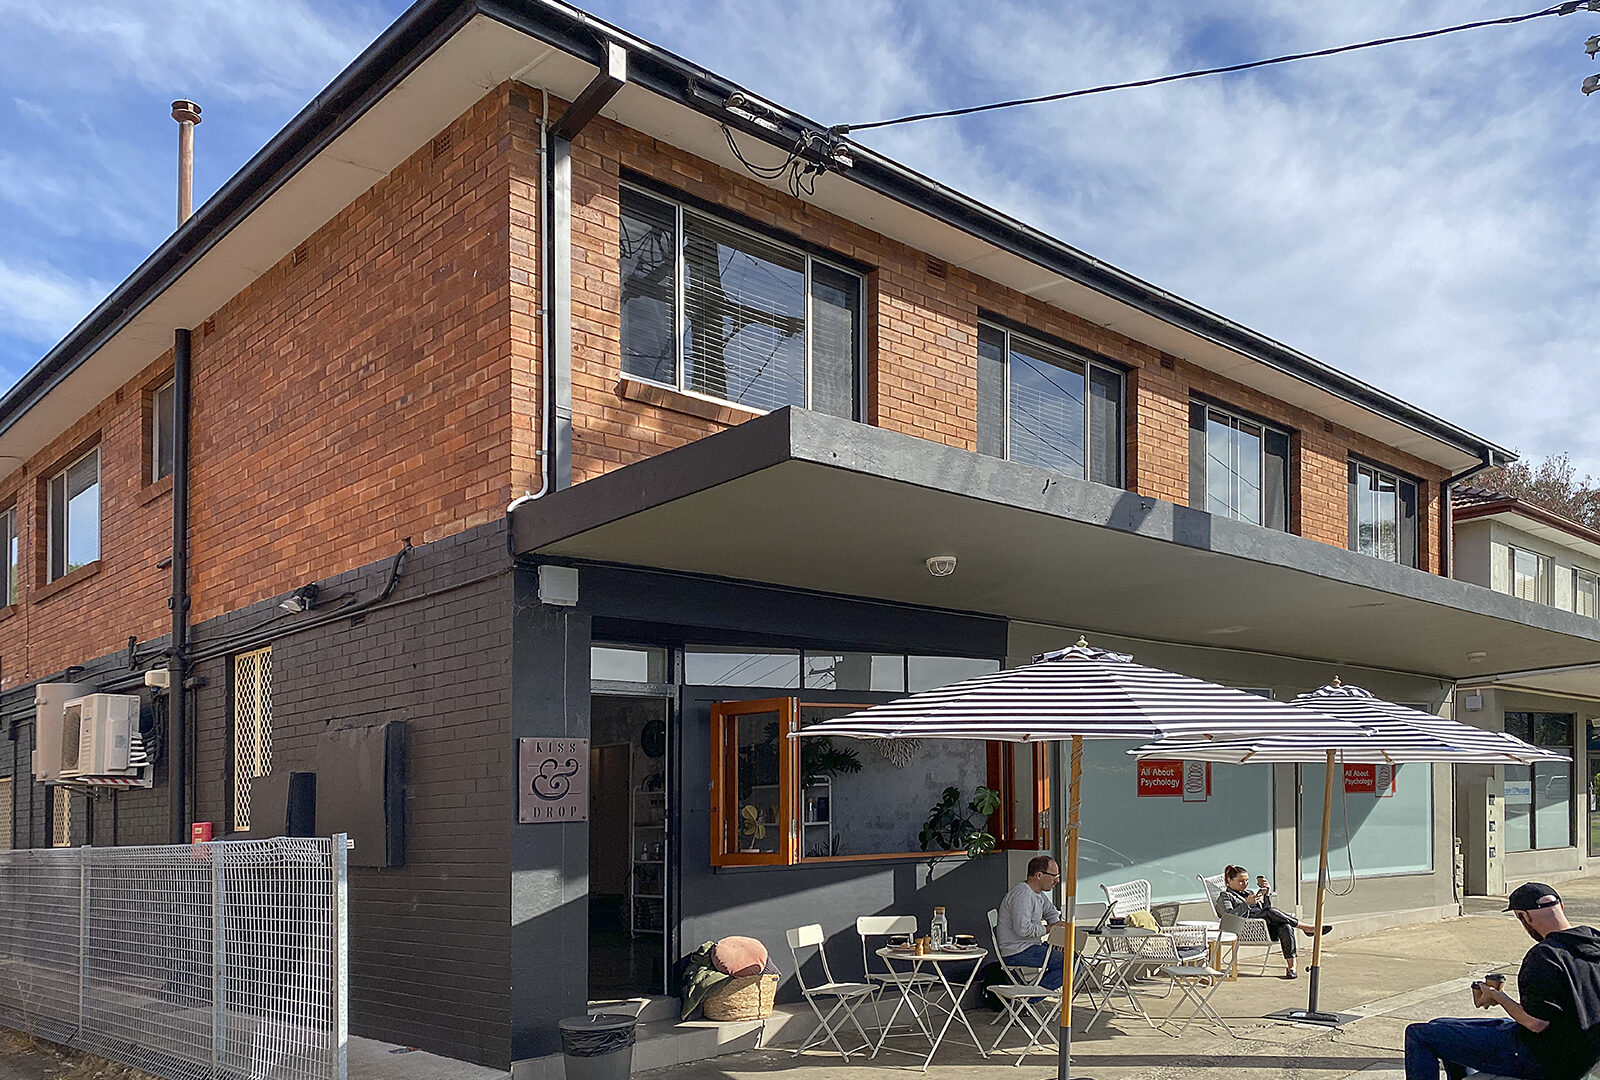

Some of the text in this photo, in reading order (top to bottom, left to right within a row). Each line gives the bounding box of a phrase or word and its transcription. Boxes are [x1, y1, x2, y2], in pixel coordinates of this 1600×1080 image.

[536, 742, 576, 753] KISS
[1140, 768, 1174, 776] All About
[531, 758, 579, 801] &
[1140, 777, 1180, 788] Psychology
[1345, 778, 1373, 786] Psychology
[533, 806, 577, 818] DROP
